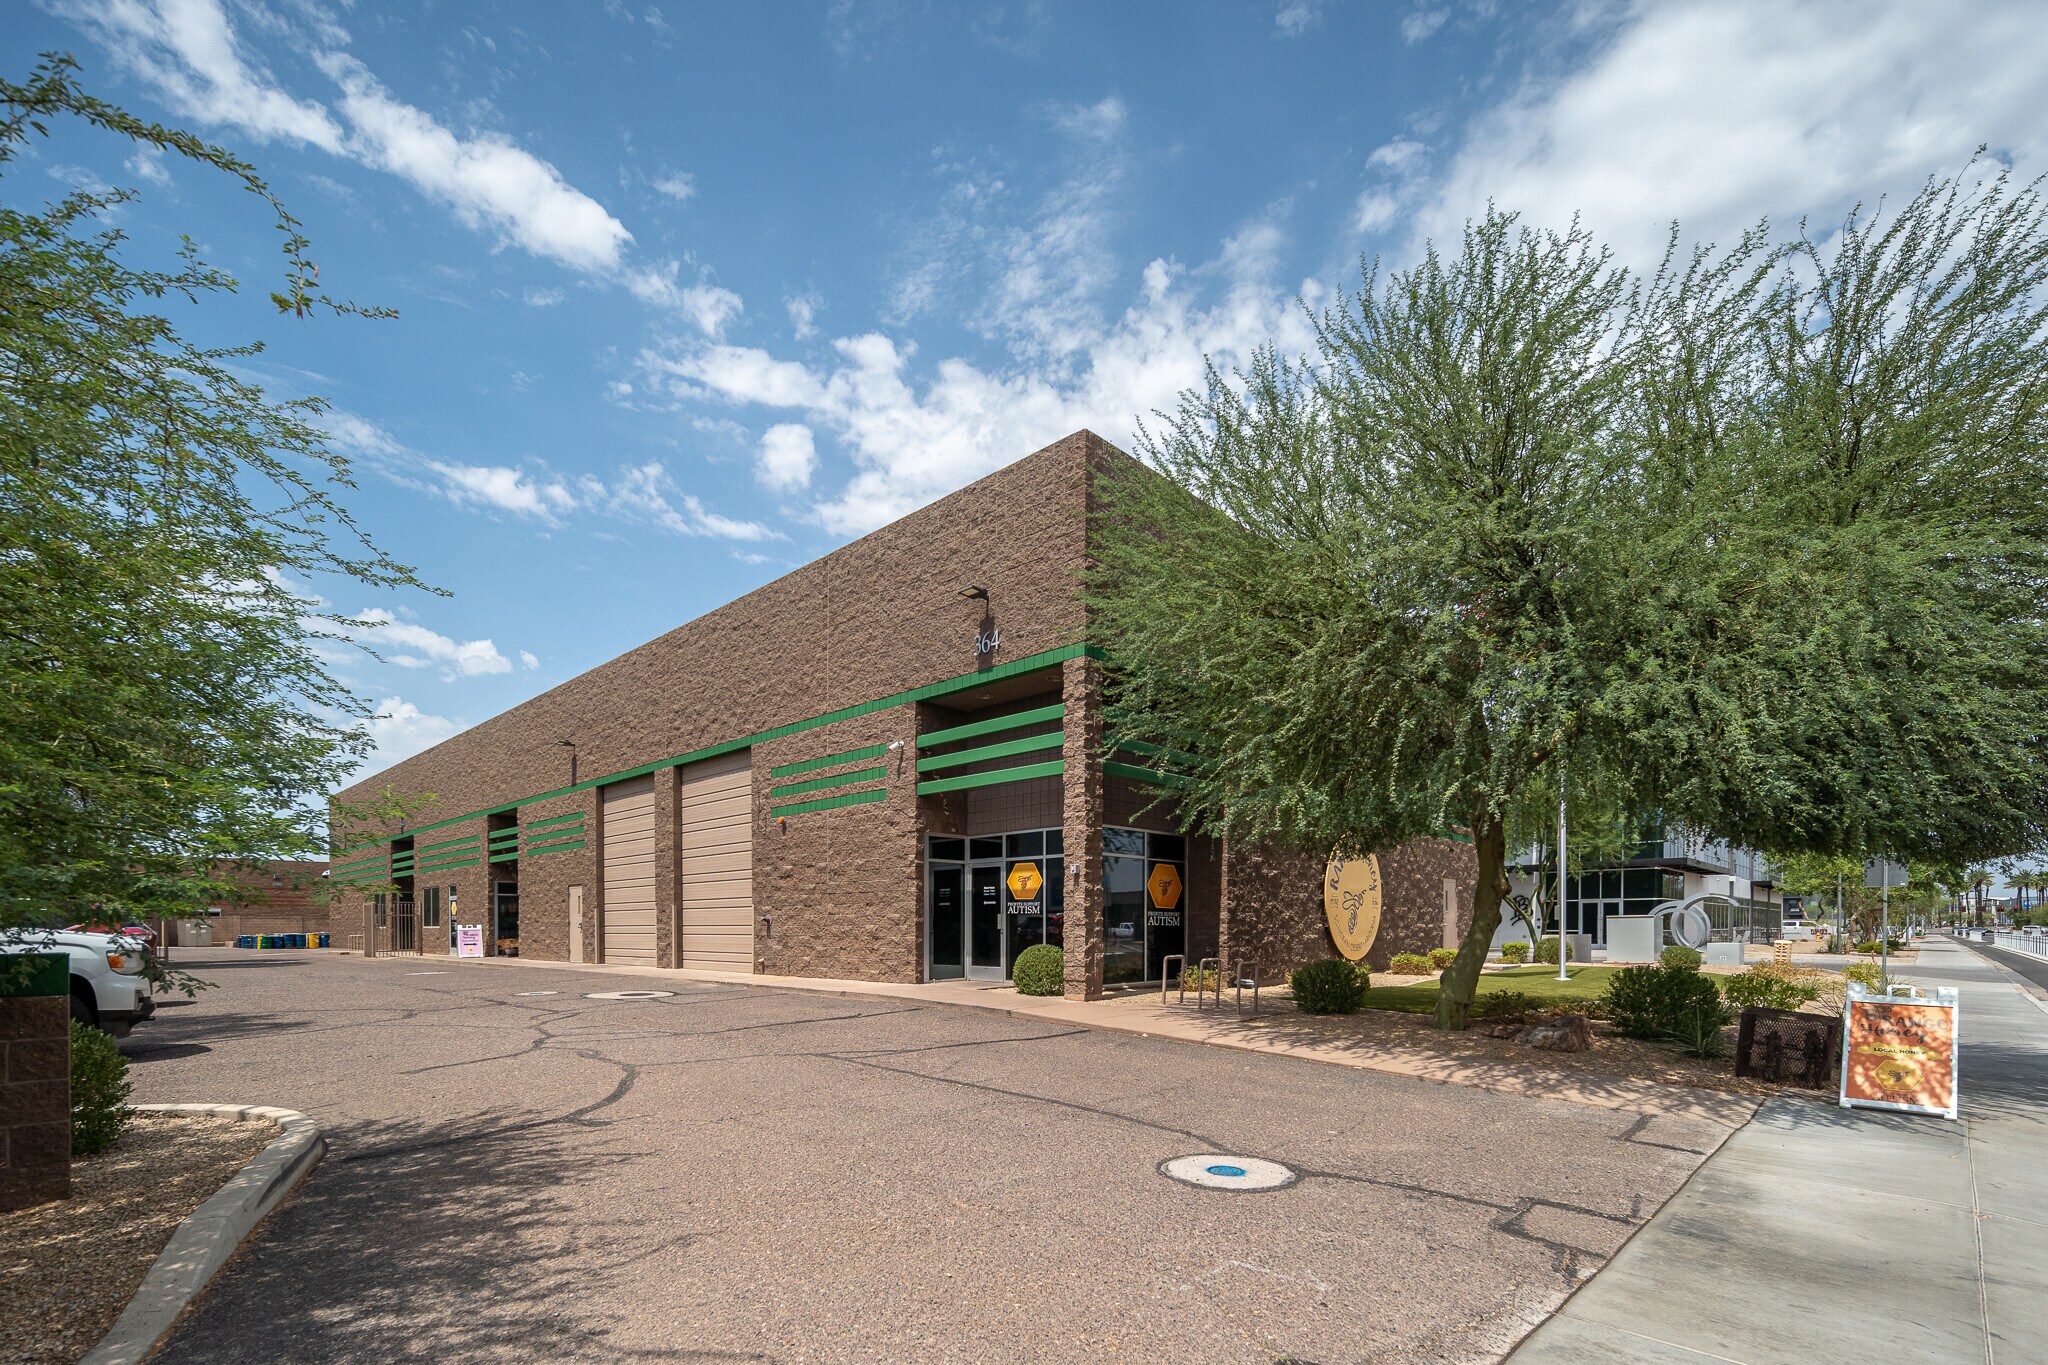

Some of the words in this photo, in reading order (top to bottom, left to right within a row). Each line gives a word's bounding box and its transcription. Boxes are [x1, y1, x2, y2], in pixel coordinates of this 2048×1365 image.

[973, 629, 1000, 656] 364
[1007, 906, 1041, 914] AUTISM
[1147, 916, 1181, 926] AUTISM
[1882, 1015, 1949, 1030] RANGO
[1860, 1023, 1928, 1044] Honey
